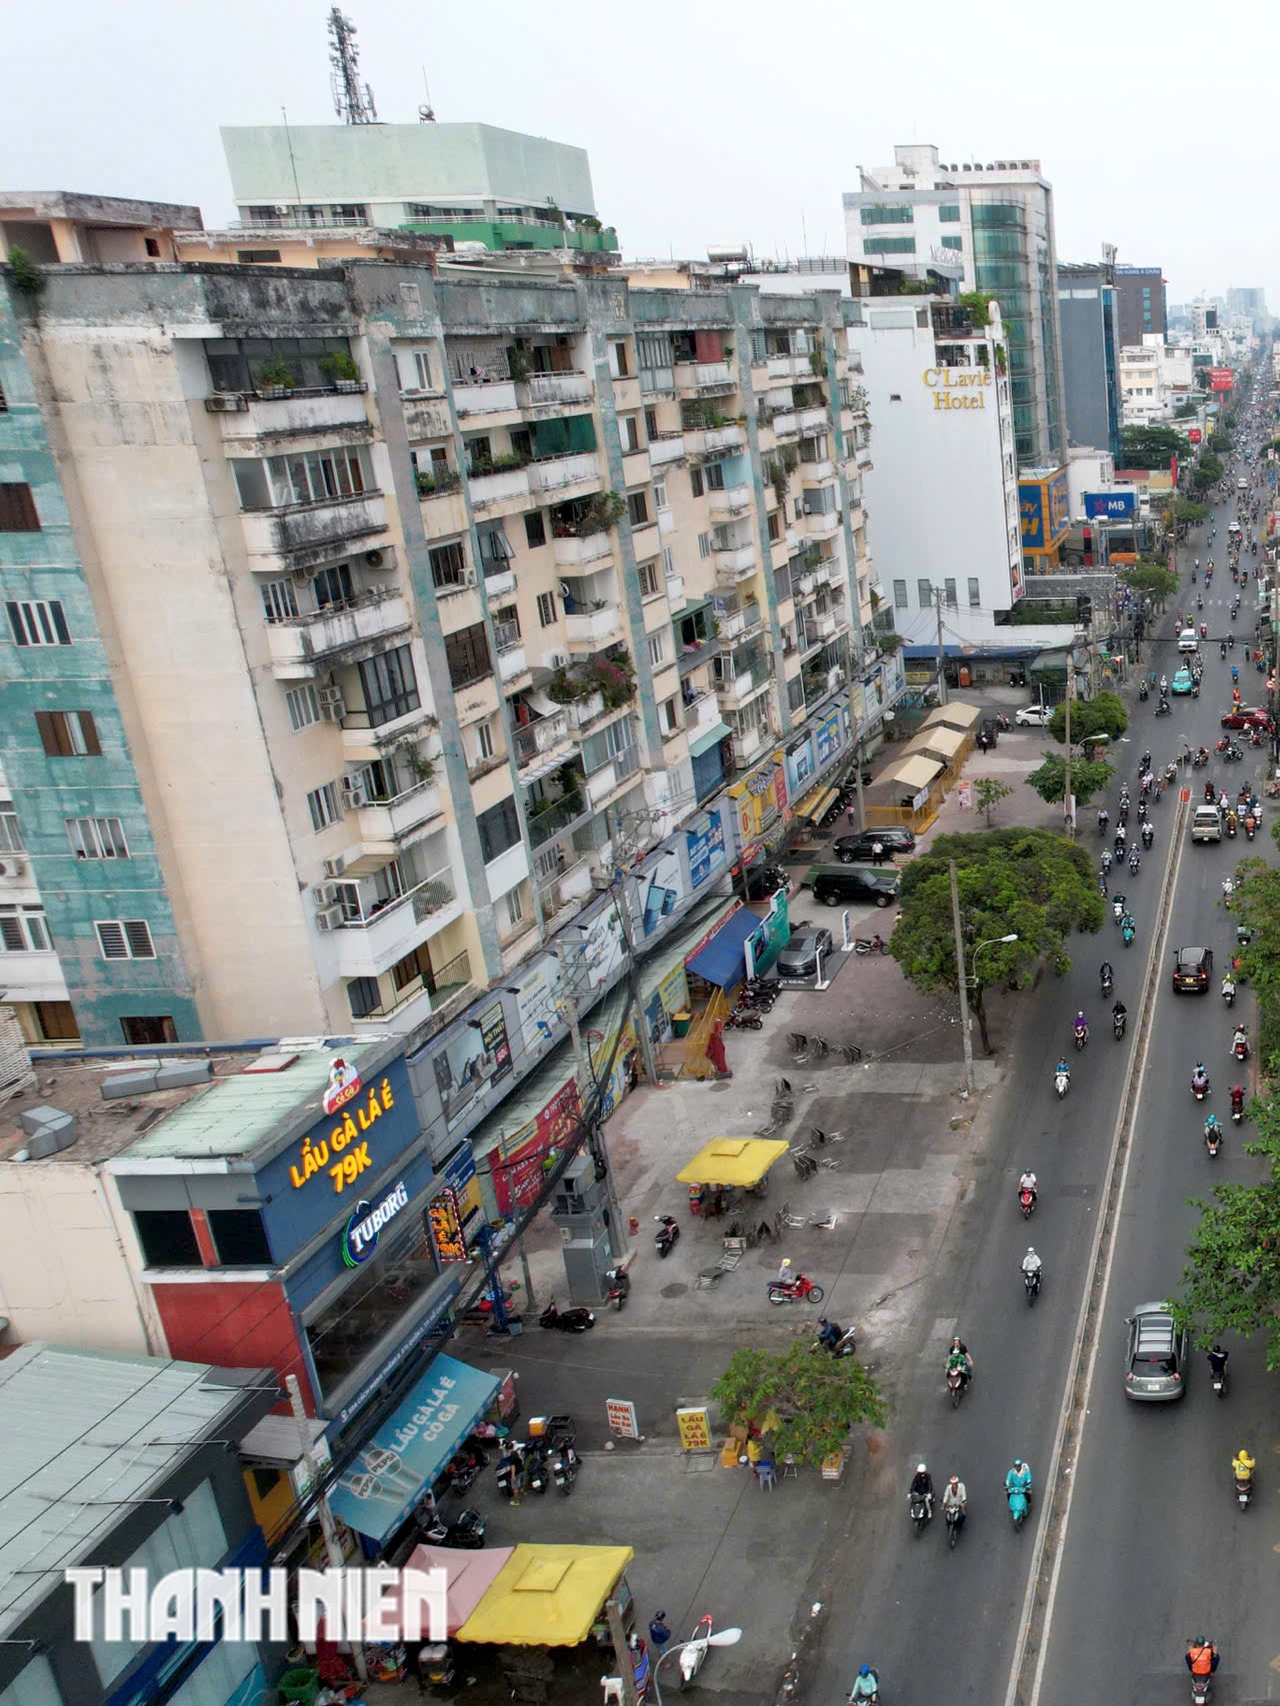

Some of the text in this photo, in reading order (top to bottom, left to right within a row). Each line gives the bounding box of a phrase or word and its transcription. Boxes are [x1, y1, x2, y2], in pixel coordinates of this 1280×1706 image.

[933, 391, 984, 410] Hotel
[1108, 501, 1126, 511] MB
[289, 1078, 394, 1190] LẨU GÀ LÁ É
[328, 1141, 372, 1194] 79K
[350, 1181, 408, 1252] TUBORG
[390, 1375, 456, 1453] LẨU GÀ LÁ É
[438, 1404, 461, 1422] GÀ
[684, 1432, 698, 1440] LÁ
[686, 1424, 702, 1432] GÀ
[372, 1453, 396, 1474] PEPSI
[358, 1476, 374, 1497] PEPSI
